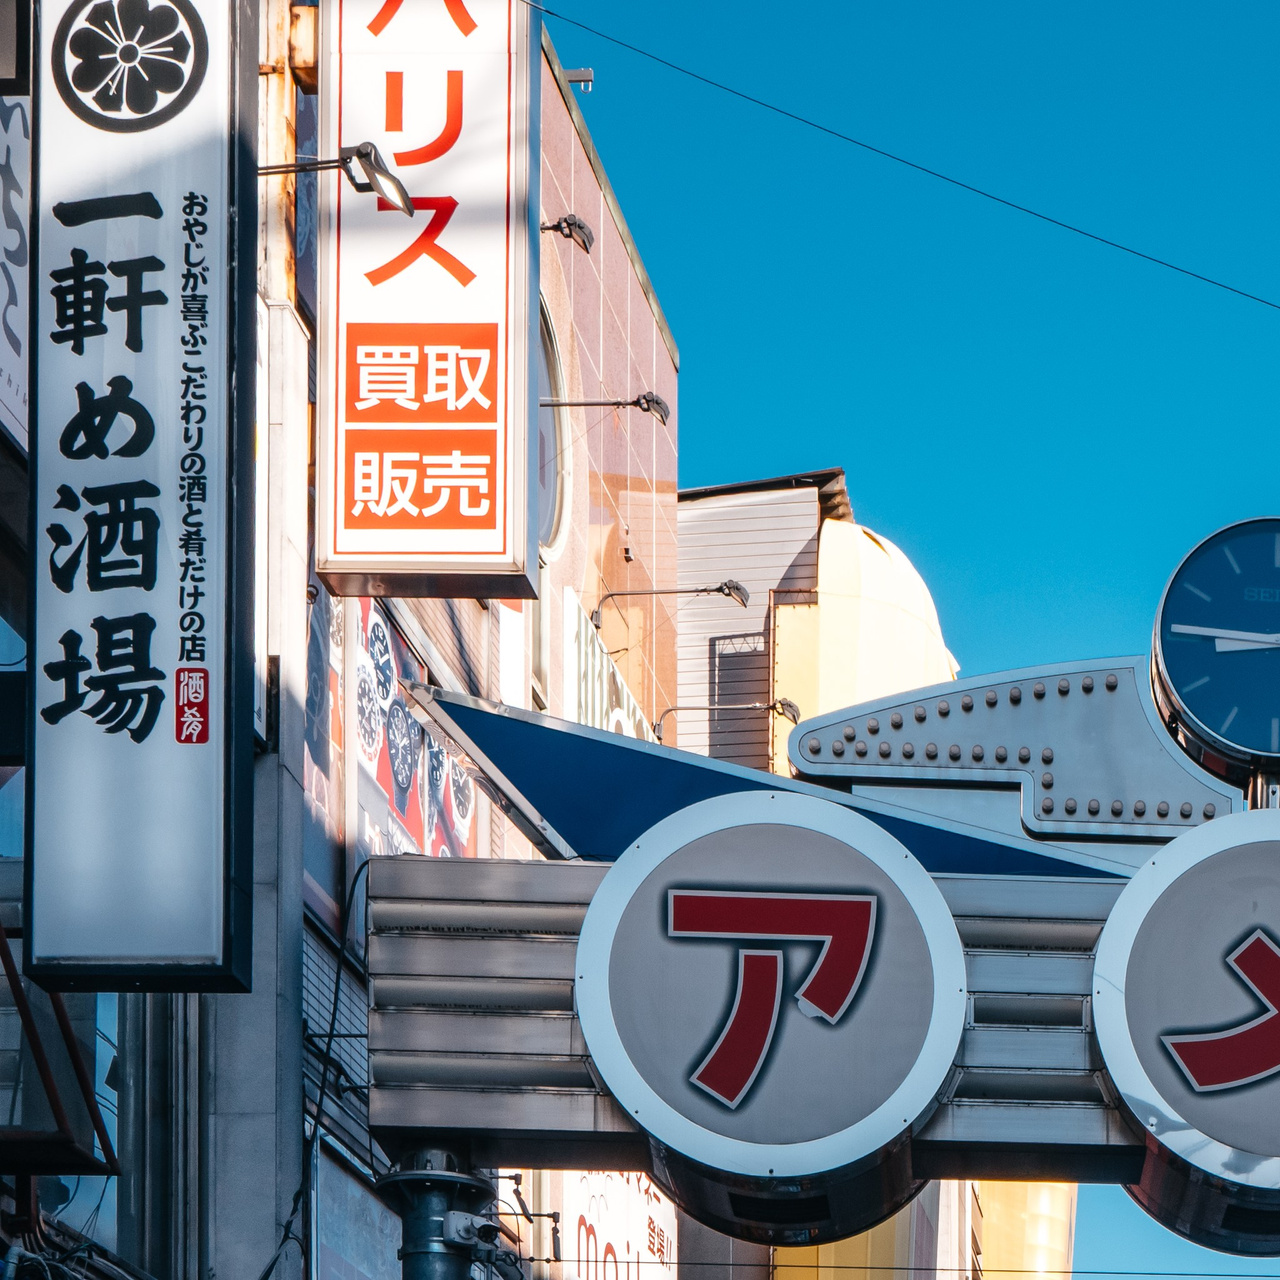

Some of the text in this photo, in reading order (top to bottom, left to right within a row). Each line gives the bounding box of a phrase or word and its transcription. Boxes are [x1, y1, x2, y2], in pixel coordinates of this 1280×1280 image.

[41, 191, 168, 745] 一軒め酒場
[179, 191, 209, 662] おやじが喜ぶこだわりの酒と肴だけの店
[351, 452, 491, 519] 販売
[355, 345, 491, 412] 買取
